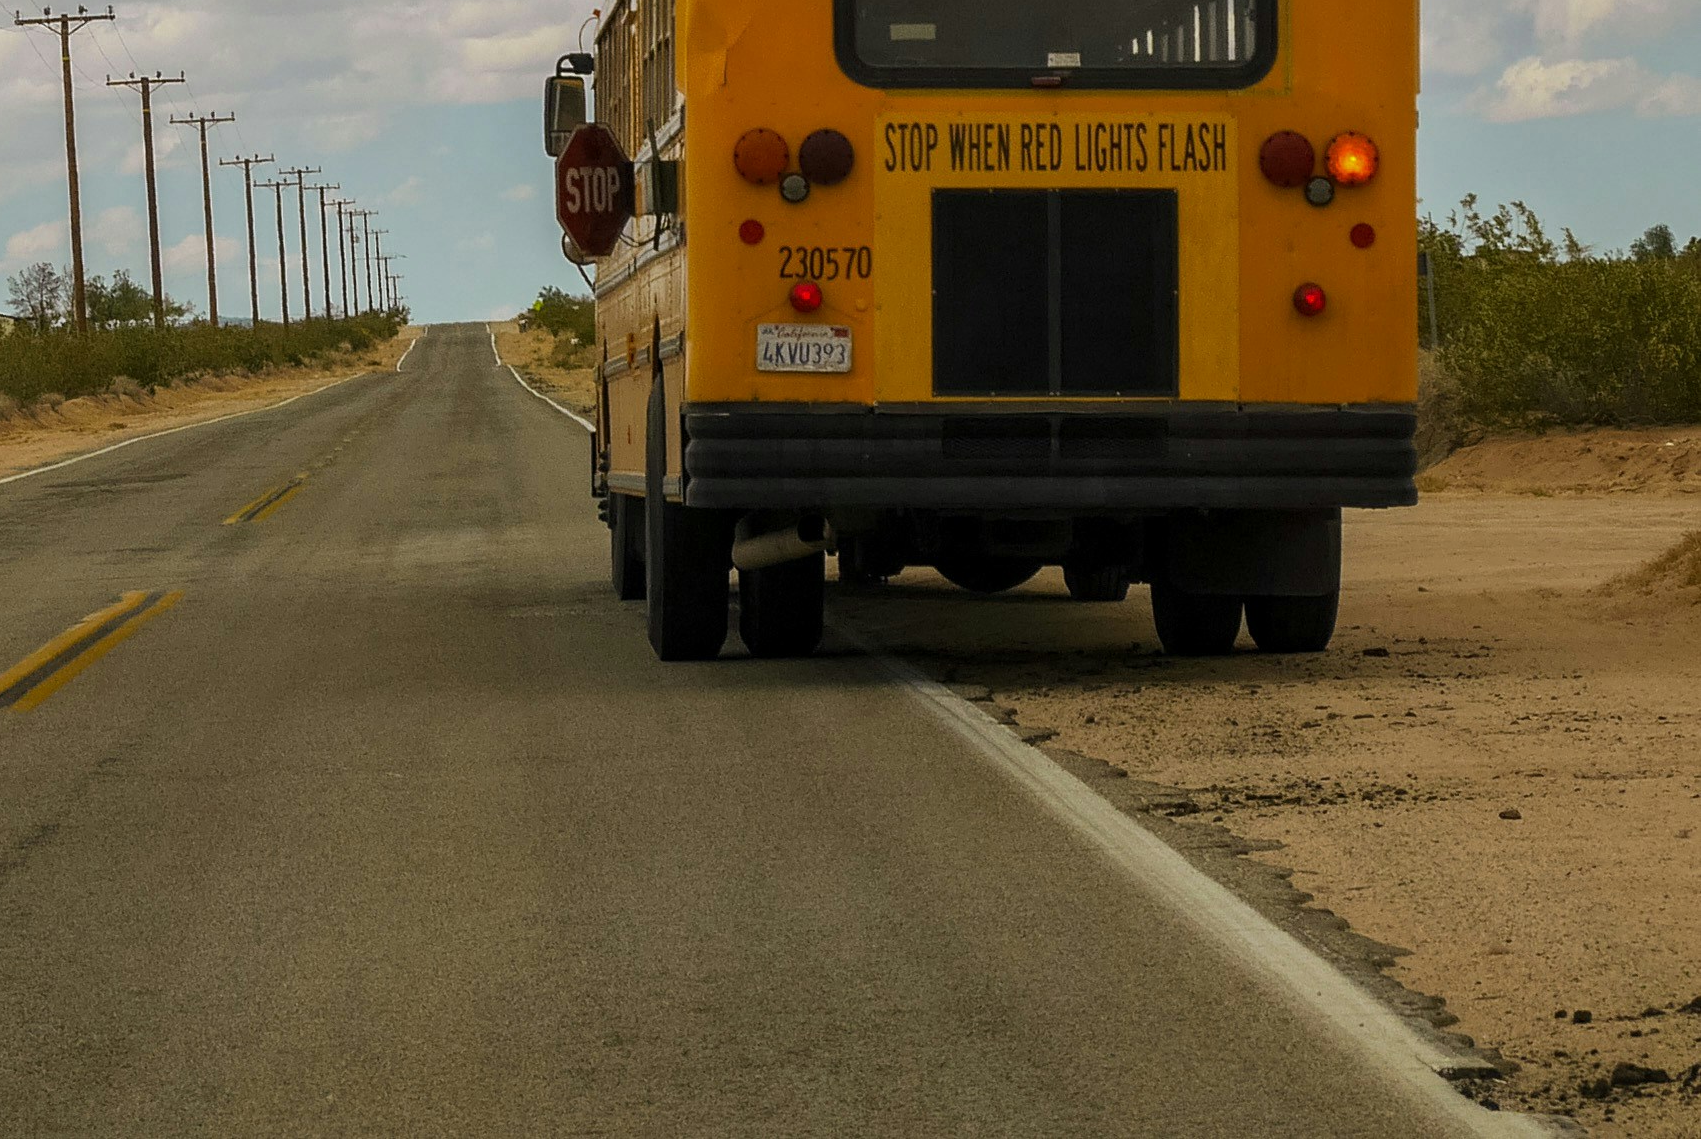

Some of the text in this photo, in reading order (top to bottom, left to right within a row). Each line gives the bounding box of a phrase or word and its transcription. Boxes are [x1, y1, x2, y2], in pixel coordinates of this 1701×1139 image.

[884, 122, 1227, 173] STOP WHEN RED LIGHTS FLASH
[565, 165, 621, 214] STOP
[779, 246, 873, 280] 230570
[776, 326, 829, 341] California
[763, 341, 846, 365] 4KVU393
